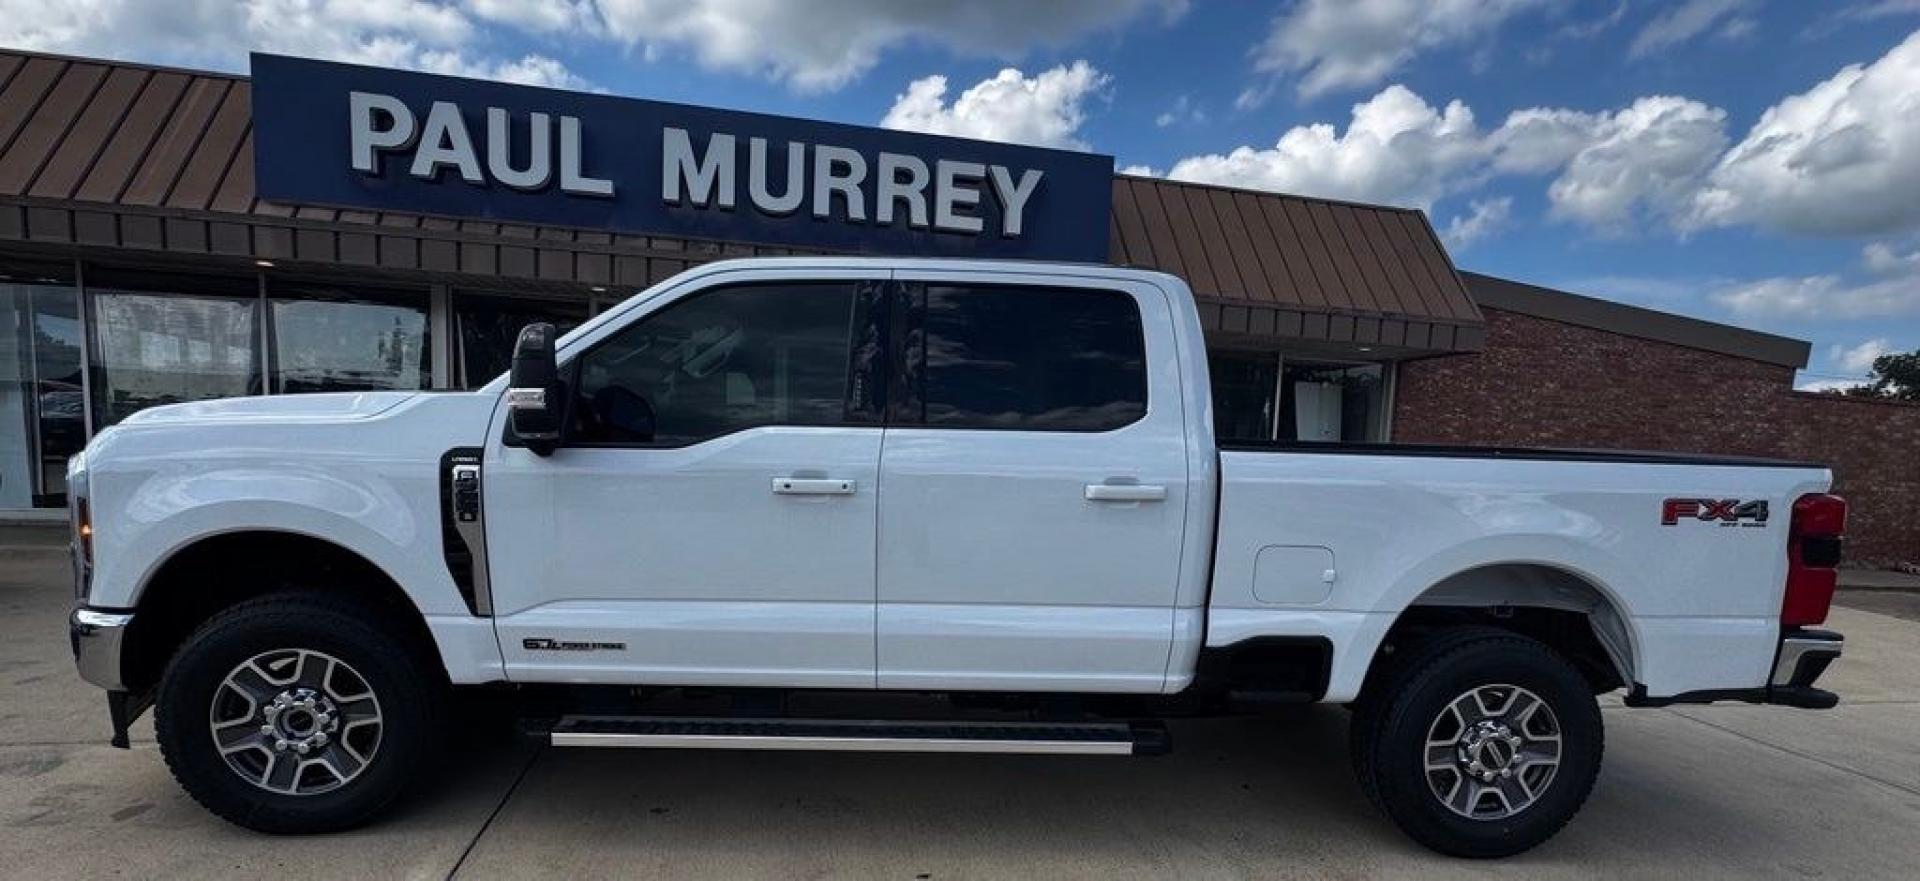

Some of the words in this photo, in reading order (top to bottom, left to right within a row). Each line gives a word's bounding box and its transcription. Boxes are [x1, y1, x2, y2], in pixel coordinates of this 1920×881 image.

[350, 91, 614, 195] PAUL
[662, 127, 1044, 235] MURREY
[1662, 499, 1769, 525] FX4
